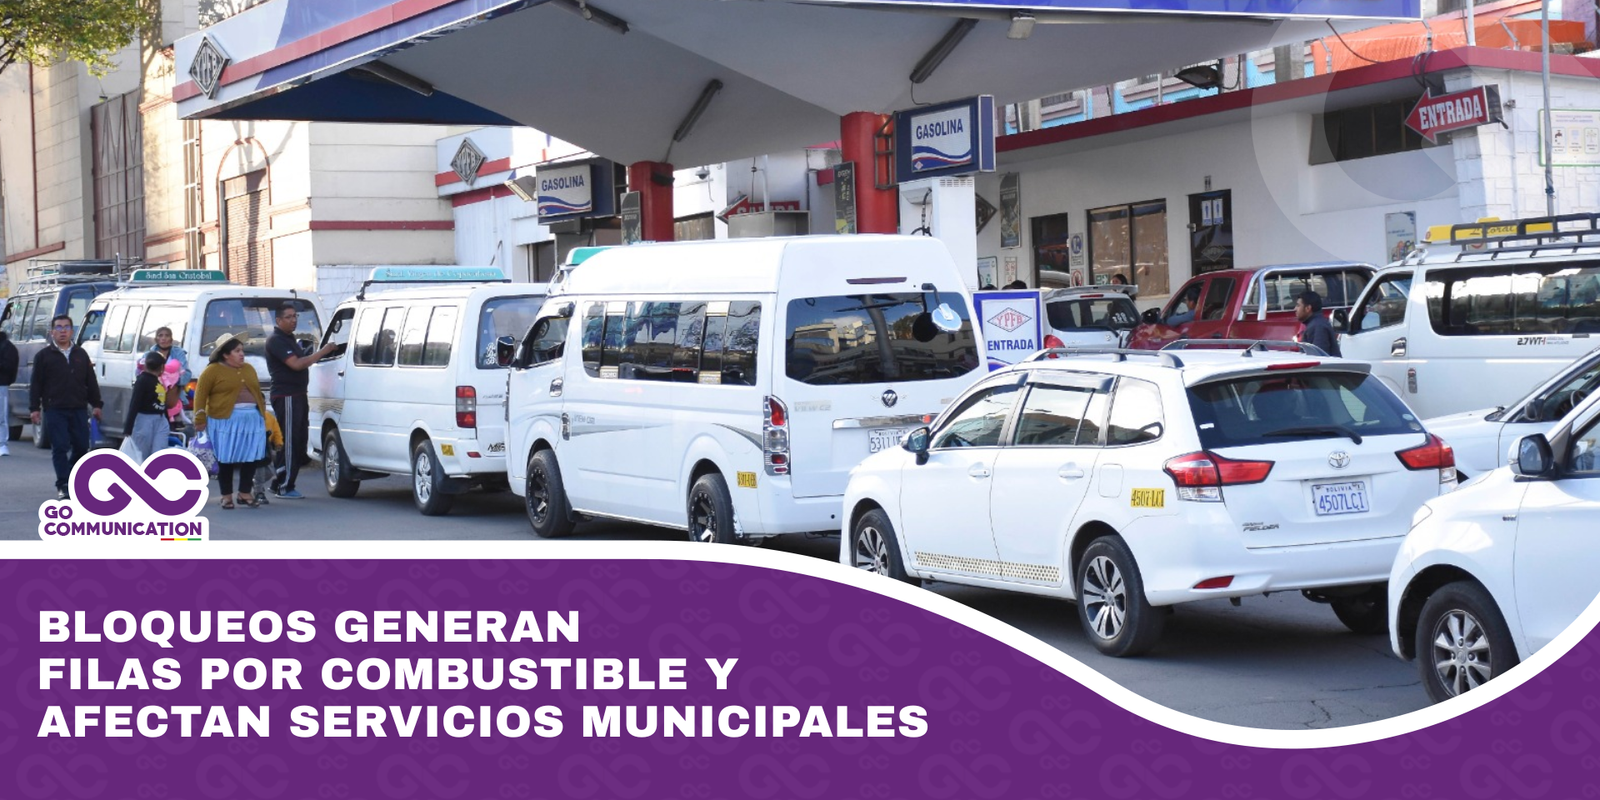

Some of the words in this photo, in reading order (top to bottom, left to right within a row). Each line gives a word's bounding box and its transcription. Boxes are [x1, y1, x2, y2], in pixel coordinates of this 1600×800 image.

[1418, 94, 1483, 130] ENTRADA
[915, 118, 964, 140] GASOLINA
[541, 174, 585, 192] GASOLINA
[996, 312, 1023, 329] YPFB
[987, 338, 1034, 351] ENTRADA
[1326, 485, 1353, 493] BOLIVIA
[1319, 492, 1365, 512] 4507LCI
